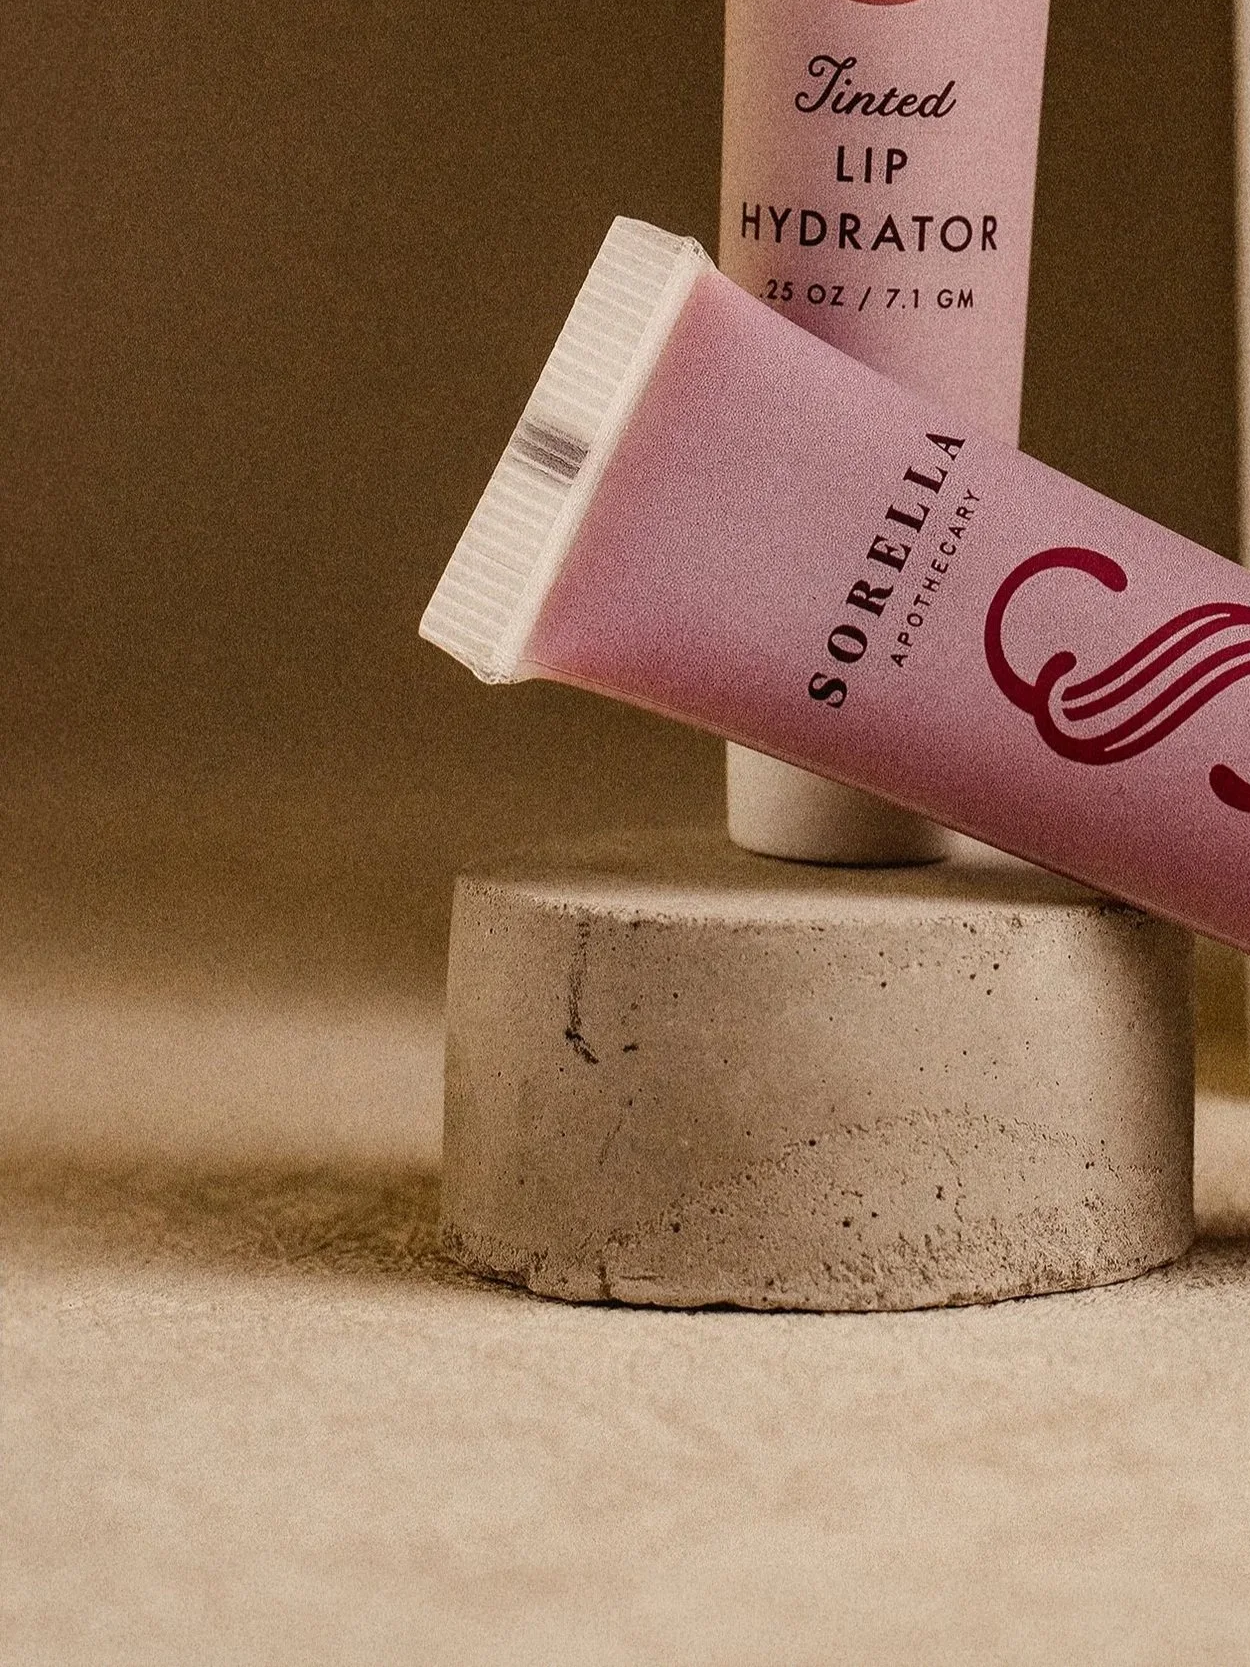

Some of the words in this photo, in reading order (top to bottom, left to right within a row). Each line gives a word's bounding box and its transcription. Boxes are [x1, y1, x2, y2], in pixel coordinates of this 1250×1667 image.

[795, 54, 957, 118] Tinted
[836, 145, 908, 184] LIP
[741, 201, 998, 252] HYDRATOR
[759, 278, 793, 301] .25
[807, 283, 844, 306] OZ
[858, 286, 872, 311] /
[886, 288, 920, 309] 7.1
[937, 288, 974, 309] GM
[808, 433, 966, 709] SORELLA
[890, 489, 980, 667] APOTHECARY
